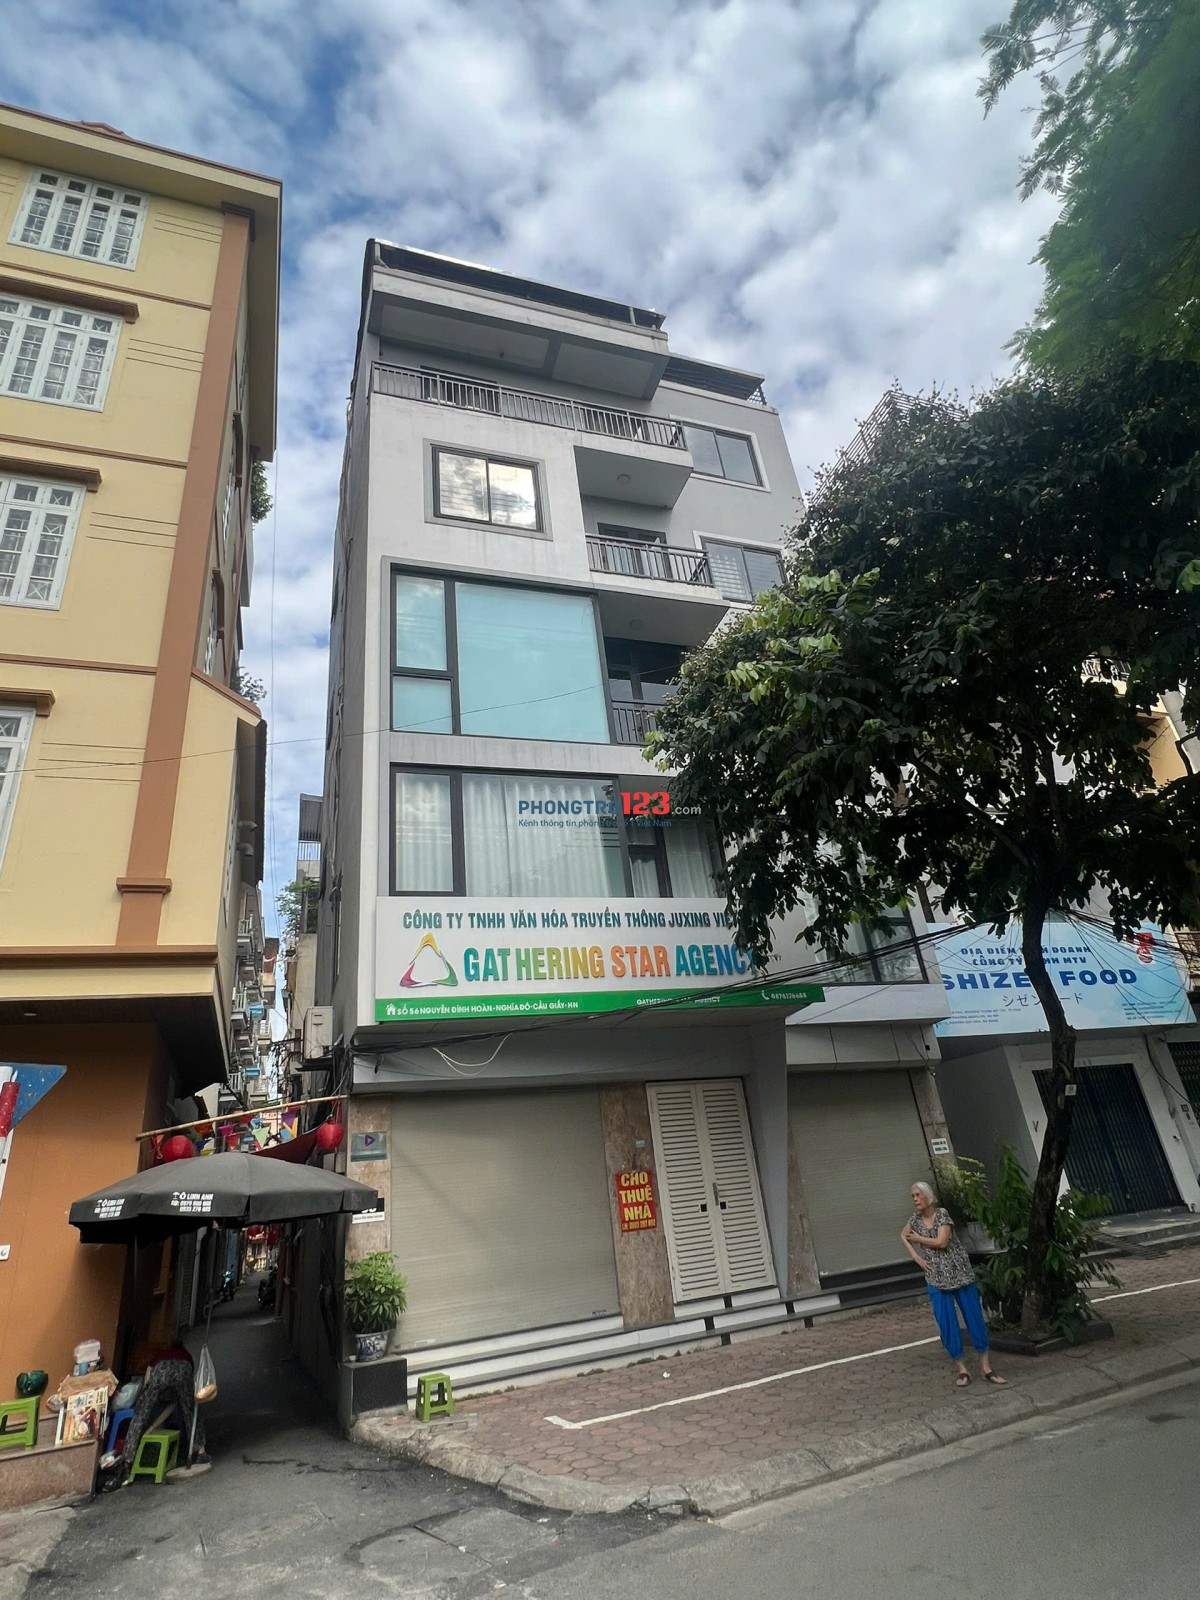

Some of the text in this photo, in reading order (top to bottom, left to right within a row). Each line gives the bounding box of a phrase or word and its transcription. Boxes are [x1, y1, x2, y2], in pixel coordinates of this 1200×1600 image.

[403, 909, 442, 929] CÔNG
[446, 912, 463, 929] TY
[468, 912, 506, 929] TNHH
[510, 908, 537, 929] VĂN
[541, 908, 568, 928] HÓA
[625, 908, 666, 928] THÔNG
[668, 911, 711, 928] JUXING
[960, 948, 983, 957] ĐỊA
[987, 944, 1016, 955] ĐIỂM
[1051, 946, 1092, 954] DOANH
[610, 945, 671, 978] STAR
[972, 955, 1005, 966] CÔNG
[1008, 958, 1023, 966] TY
[942, 969, 1137, 990] SHIZE FOOD
[396, 1003, 408, 1015] SỐ
[409, 1006, 420, 1015] 56
[620, 1171, 649, 1187] CHO
[619, 1185, 653, 1204] THUÊ
[623, 1202, 652, 1221] NHÀ
